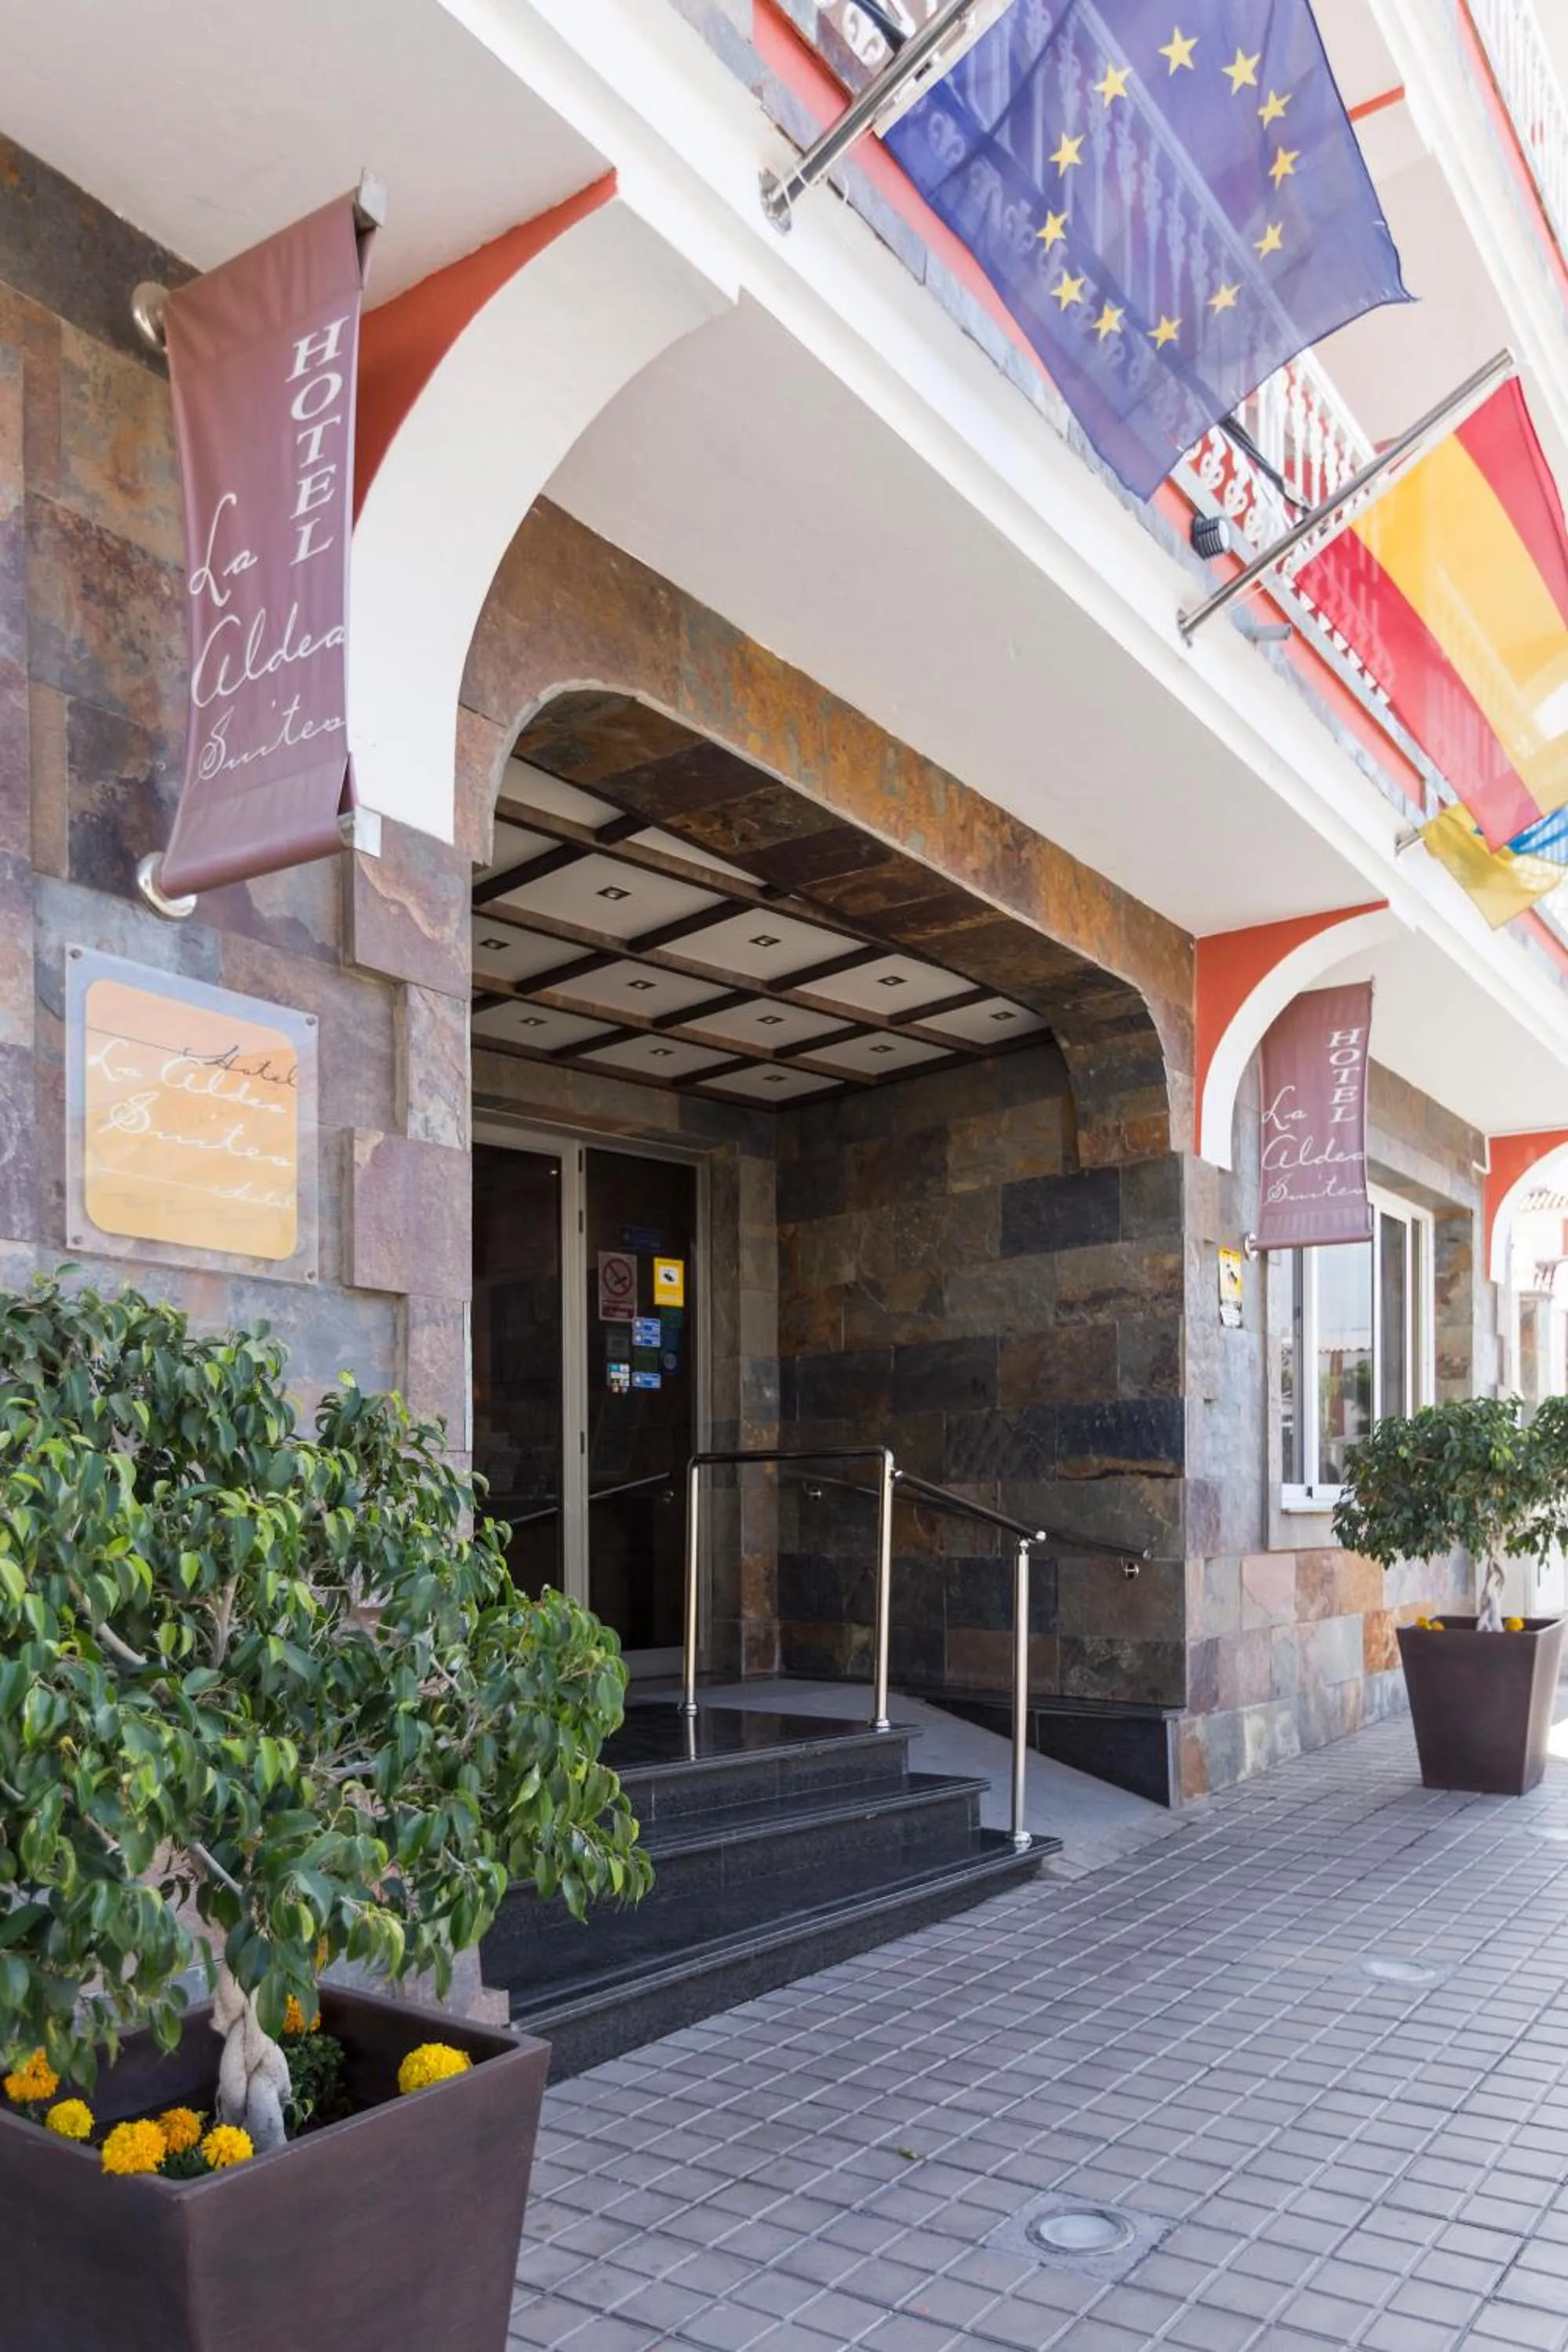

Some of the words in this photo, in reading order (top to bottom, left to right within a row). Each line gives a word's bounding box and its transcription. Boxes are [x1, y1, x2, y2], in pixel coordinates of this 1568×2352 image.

[285, 315, 350, 566] HOTEL
[190, 493, 259, 607] La
[191, 602, 347, 707] Aldea
[86, 1039, 144, 1083] La
[161, 1056, 287, 1113] Aldea
[1261, 1086, 1308, 1131] La
[1327, 1029, 1361, 1123] HOTEL
[1261, 1134, 1366, 1171] Aldea
